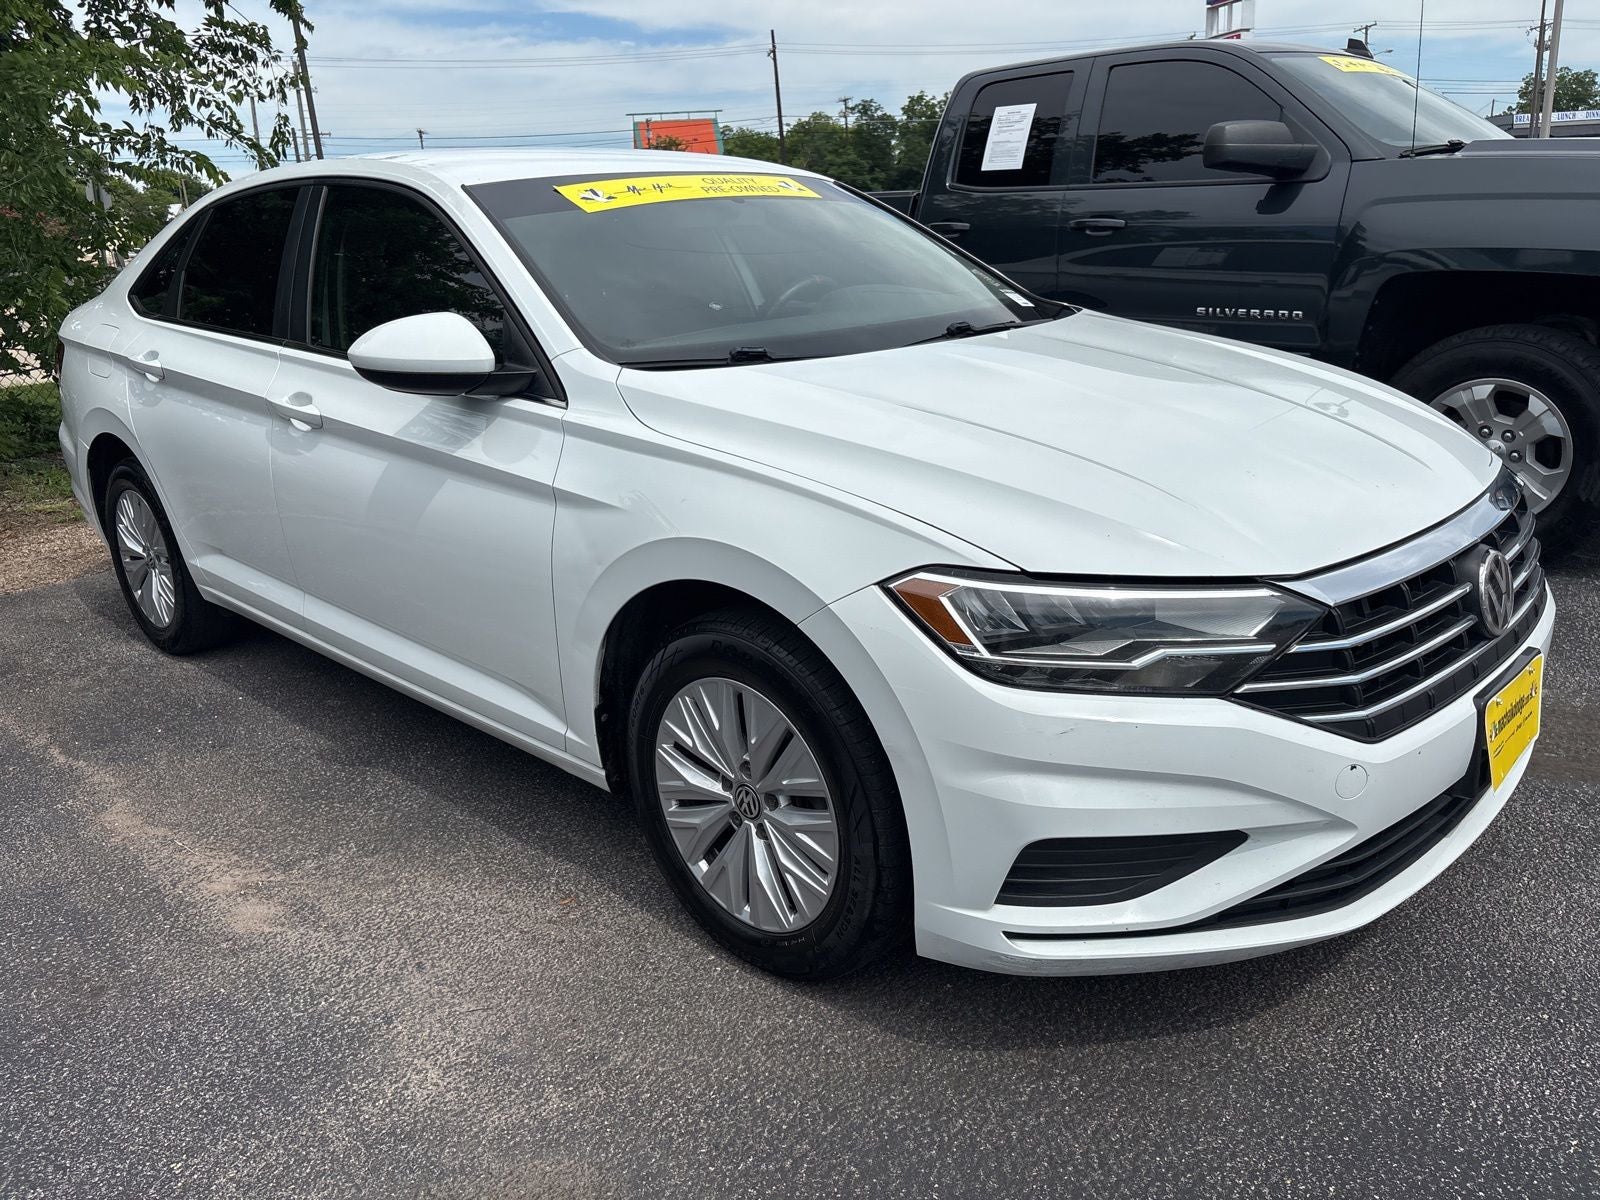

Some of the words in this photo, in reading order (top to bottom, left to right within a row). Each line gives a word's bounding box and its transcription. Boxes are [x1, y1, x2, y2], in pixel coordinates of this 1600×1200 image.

[1557, 112, 1577, 121] LUNCH
[701, 177, 758, 185] QUALITY
[700, 185, 781, 194] PRE-OWNED
[1196, 307, 1303, 320] SILVERADO
